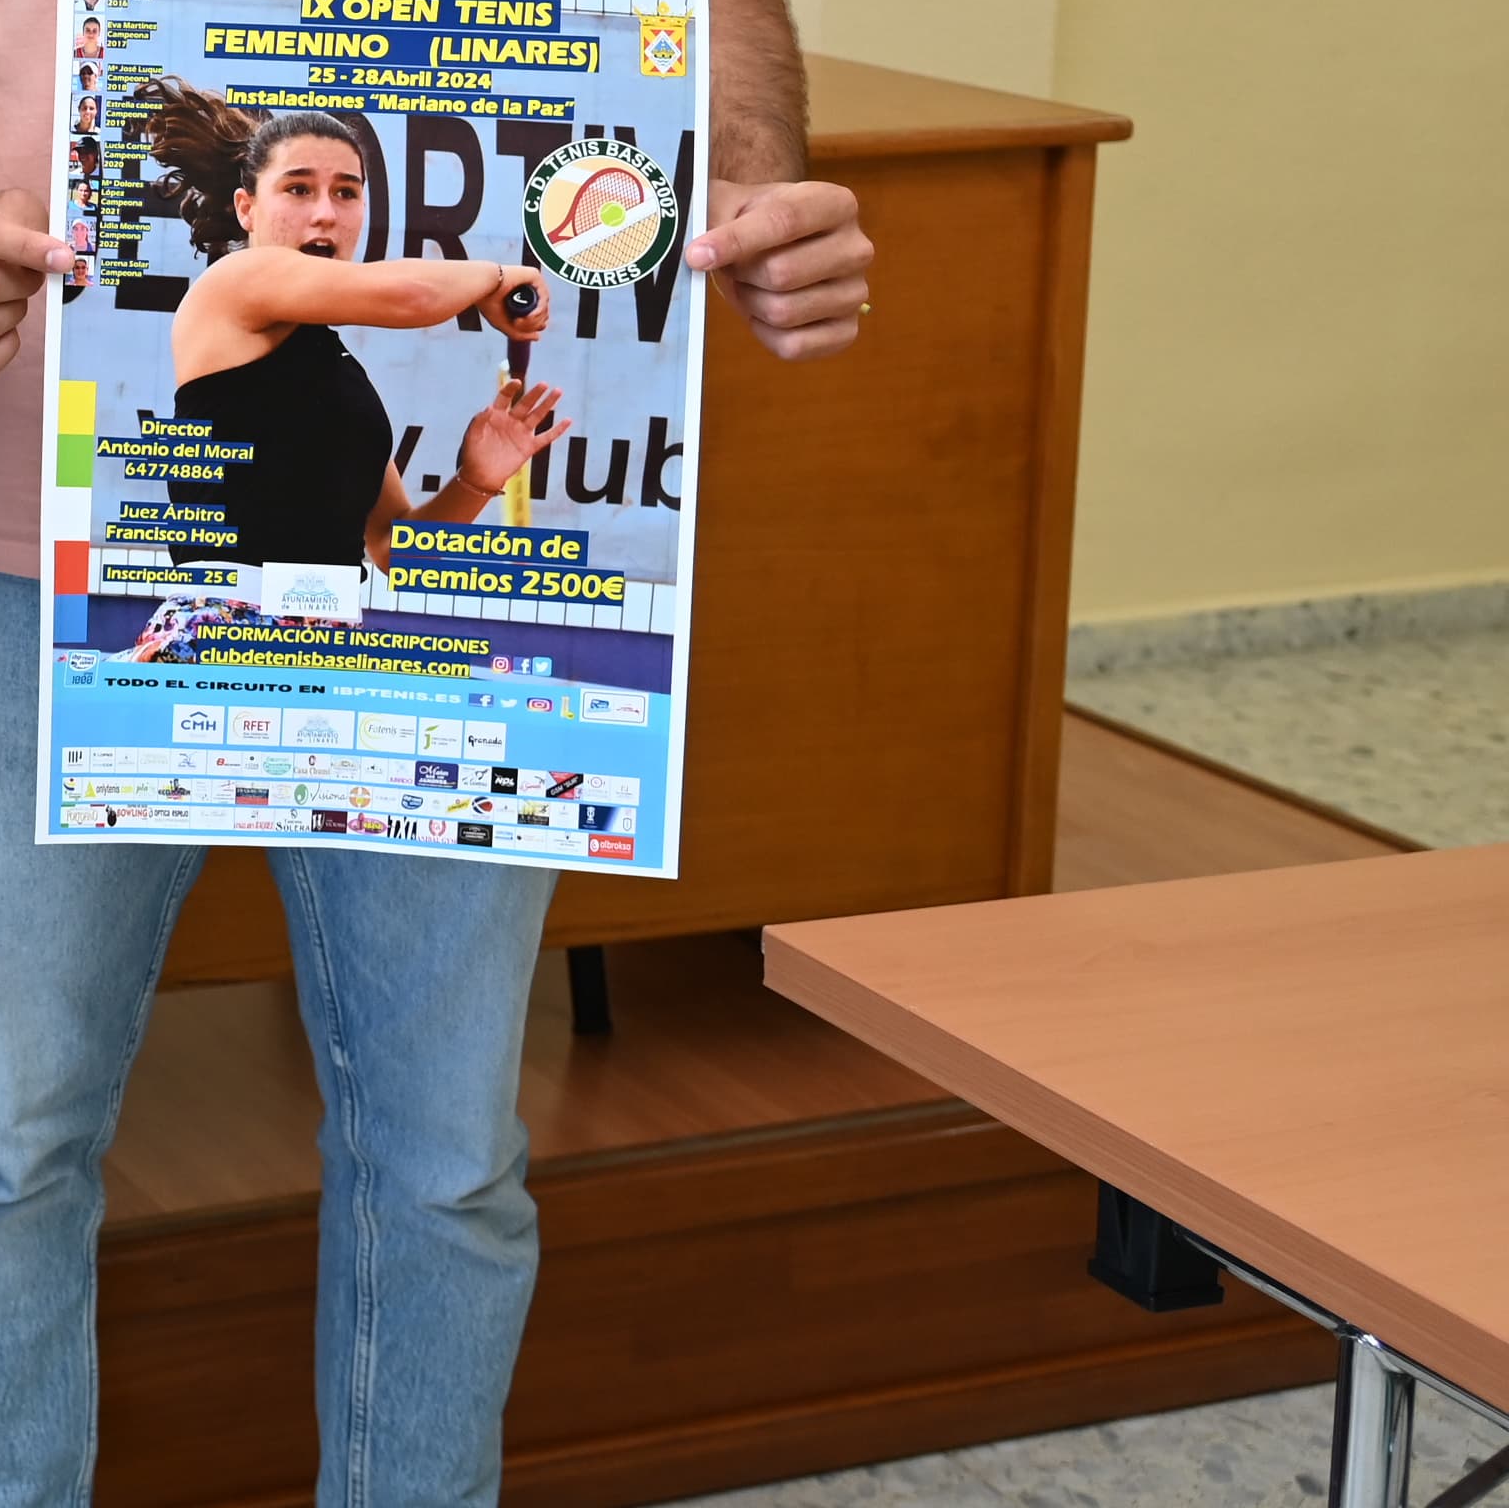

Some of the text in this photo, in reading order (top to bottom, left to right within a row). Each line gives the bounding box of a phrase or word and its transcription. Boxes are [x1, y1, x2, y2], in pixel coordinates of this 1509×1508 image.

[454, 0, 555, 27] TENIS
[107, 31, 149, 39] Campeona
[204, 28, 600, 72] FEMENINO (LINARES)
[119, 65, 136, 73] José
[138, 66, 163, 74] Luque
[108, 75, 149, 83] Campeona
[308, 67, 335, 84] 25
[352, 68, 432, 88] 28Abril
[435, 71, 492, 90] 2024
[106, 101, 134, 109] Estrella
[226, 88, 365, 110] Instalaciones
[469, 96, 495, 114] de
[501, 98, 522, 115] la
[106, 110, 148, 118] Campeona
[126, 143, 152, 151] Cortez
[104, 151, 146, 160] Campeona
[545, 142, 600, 172] TENIS
[606, 143, 657, 177] BASE
[652, 177, 675, 218] 2002
[101, 189, 124, 197] López
[101, 199, 143, 207] Campeona
[100, 222, 151, 231] Lidia Moreno
[100, 232, 141, 240] Campeona
[101, 260, 128, 268] Lorena
[101, 269, 142, 277] Campeona
[559, 263, 641, 286] LINARES
[141, 420, 212, 437] Director
[97, 440, 254, 460] Antonio del Moral
[125, 463, 224, 480] 647748864
[120, 503, 225, 522] Juez Árbitro
[106, 525, 238, 547] Francisco Hoyo
[390, 525, 580, 560] Dotación de
[106, 567, 237, 584] Inscripción: 25 €
[389, 566, 624, 600] premios 2500€
[281, 596, 339, 605] AYUNTAMIENTO
[299, 603, 339, 612] LINARES
[197, 624, 490, 655] INFORMACIÓN E INSCRIPCIONES
[200, 647, 470, 678] clubdetenisbaselinares.com
[104, 677, 462, 704] TODO EL CIRCUITO EN IBPTENIS.ES
[181, 720, 217, 731] CMH
[243, 721, 271, 732] RFET
